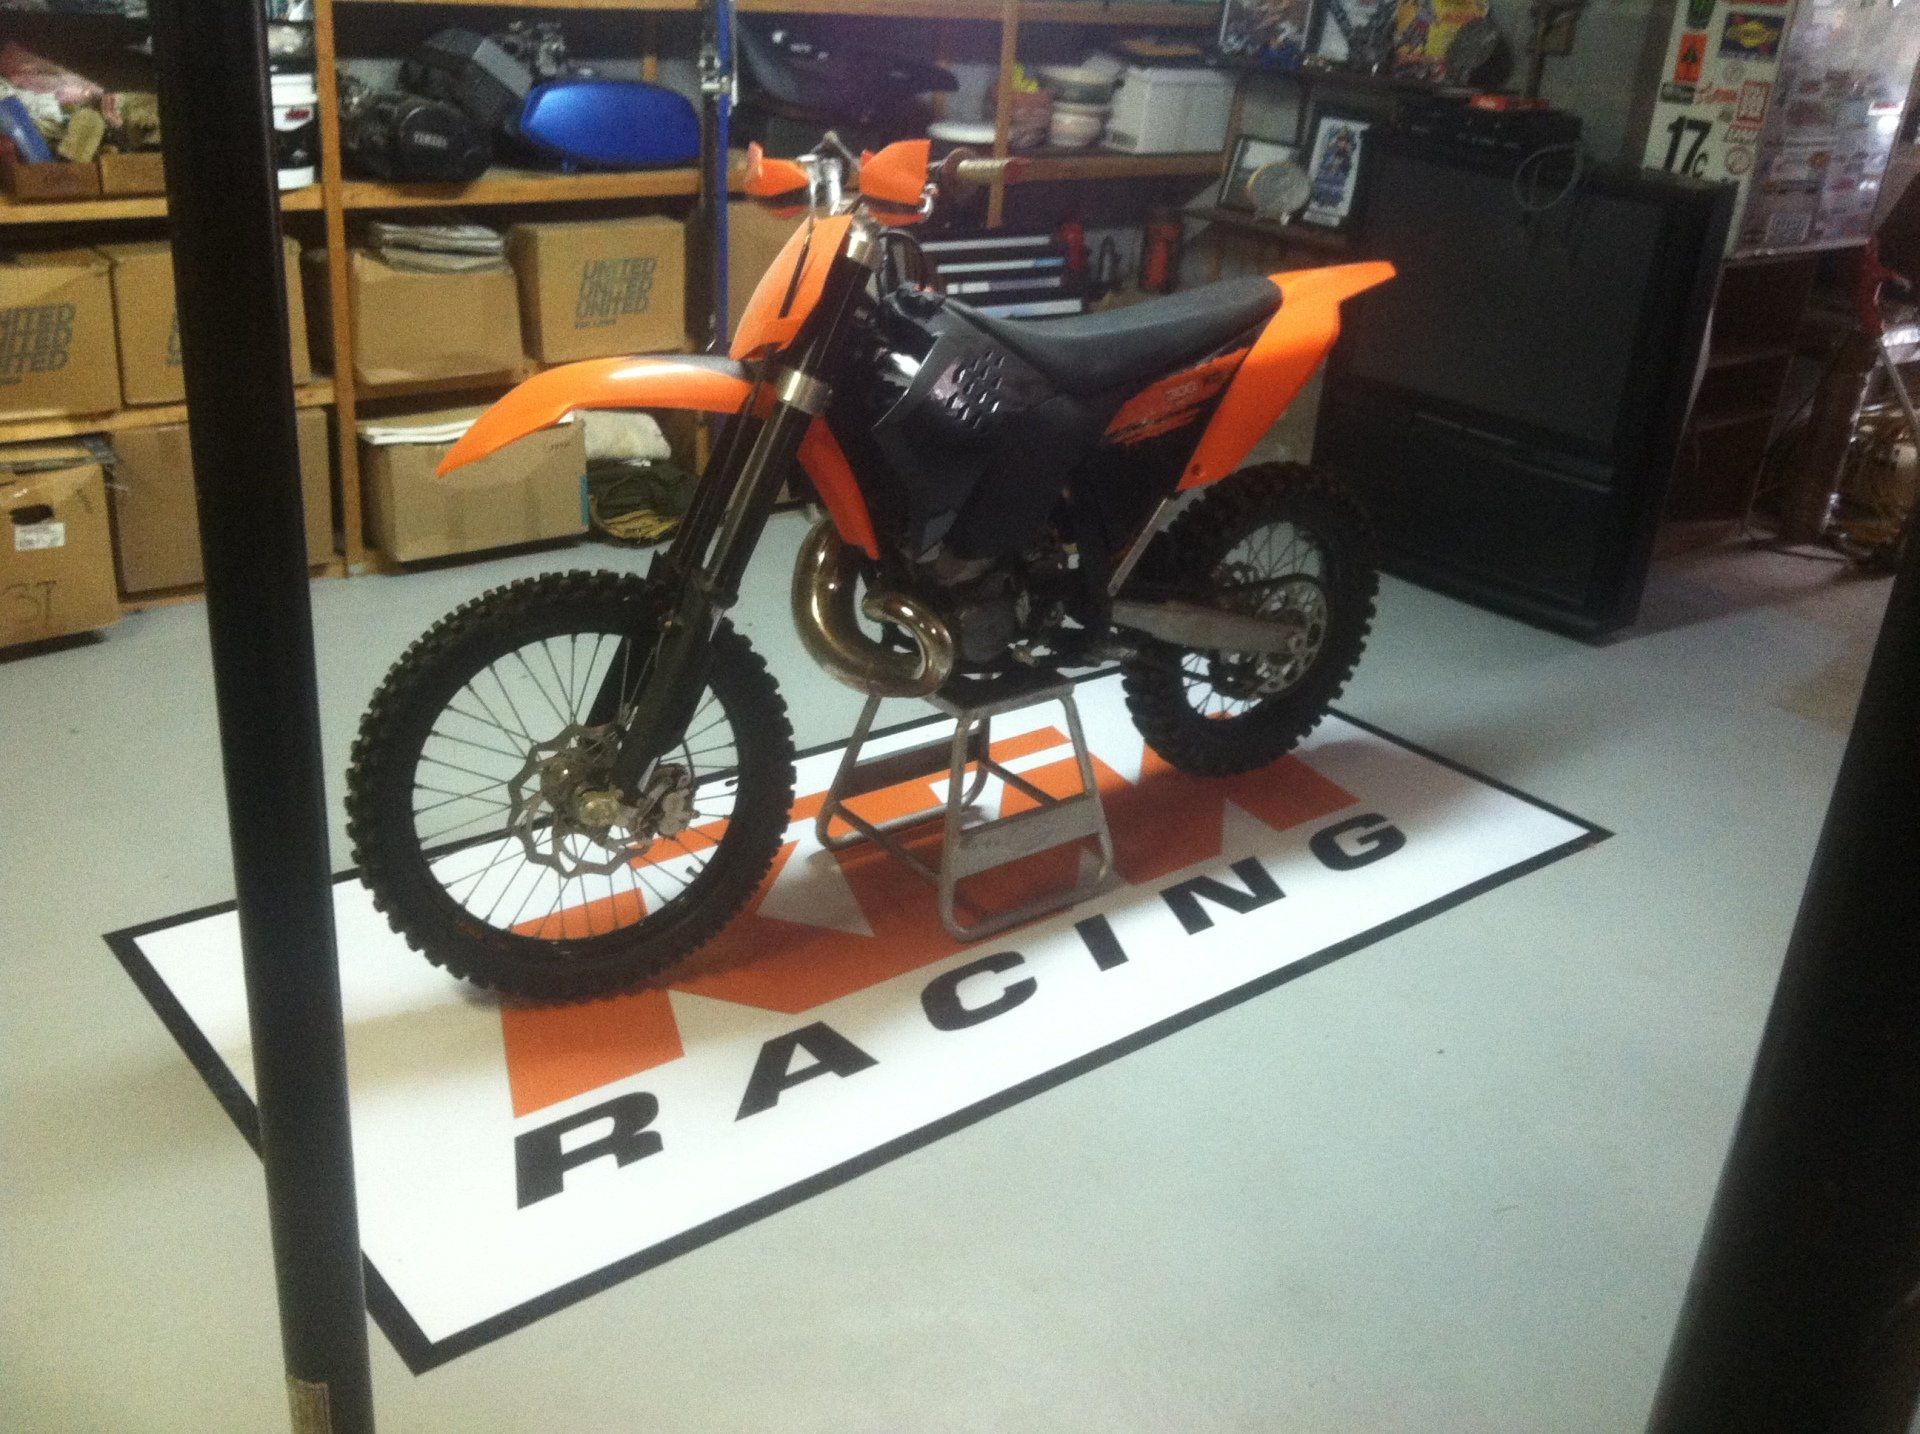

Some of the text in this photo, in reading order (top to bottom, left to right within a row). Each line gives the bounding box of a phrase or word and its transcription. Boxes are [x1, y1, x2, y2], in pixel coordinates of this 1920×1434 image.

[583, 258, 657, 281] UNITED
[579, 274, 654, 300] UNITED
[575, 292, 650, 319] UNITED
[515, 812, 1406, 1210] RACING
